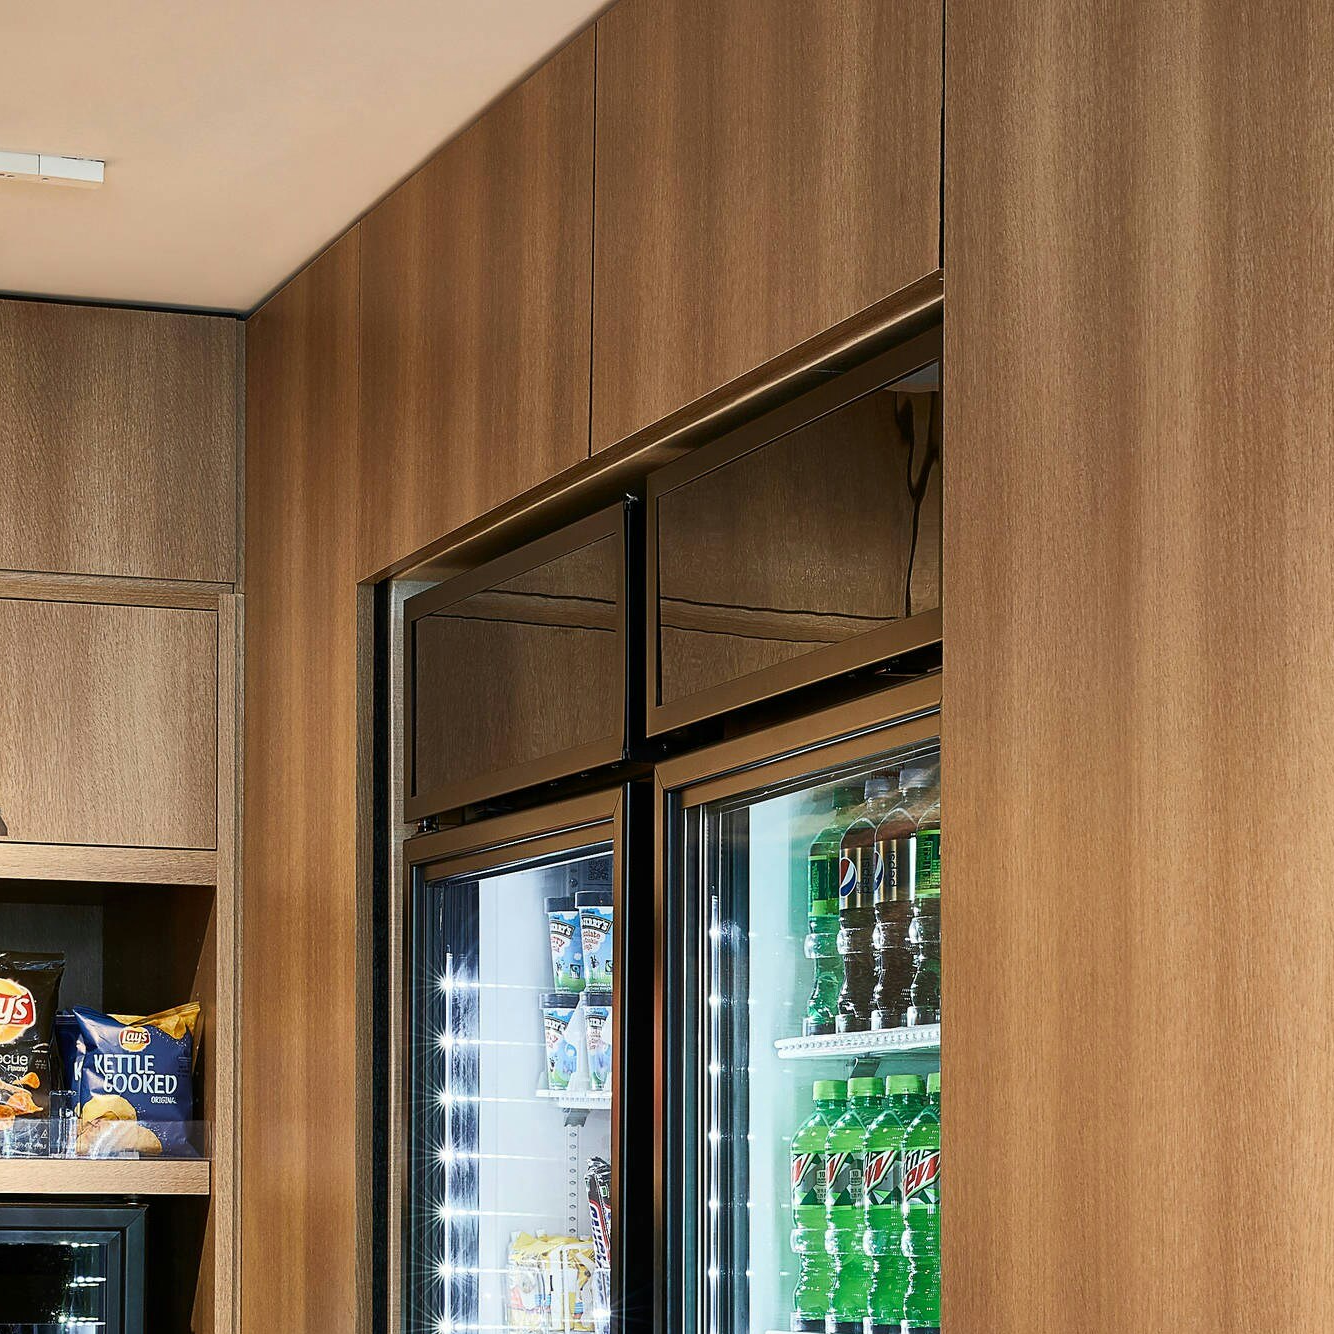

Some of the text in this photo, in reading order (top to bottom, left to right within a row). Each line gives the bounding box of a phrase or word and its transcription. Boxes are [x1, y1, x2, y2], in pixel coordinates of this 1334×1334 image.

[93, 1053, 155, 1076] KETTLE
[103, 1073, 178, 1094] COOKED
[852, 1170, 859, 1178] 10
